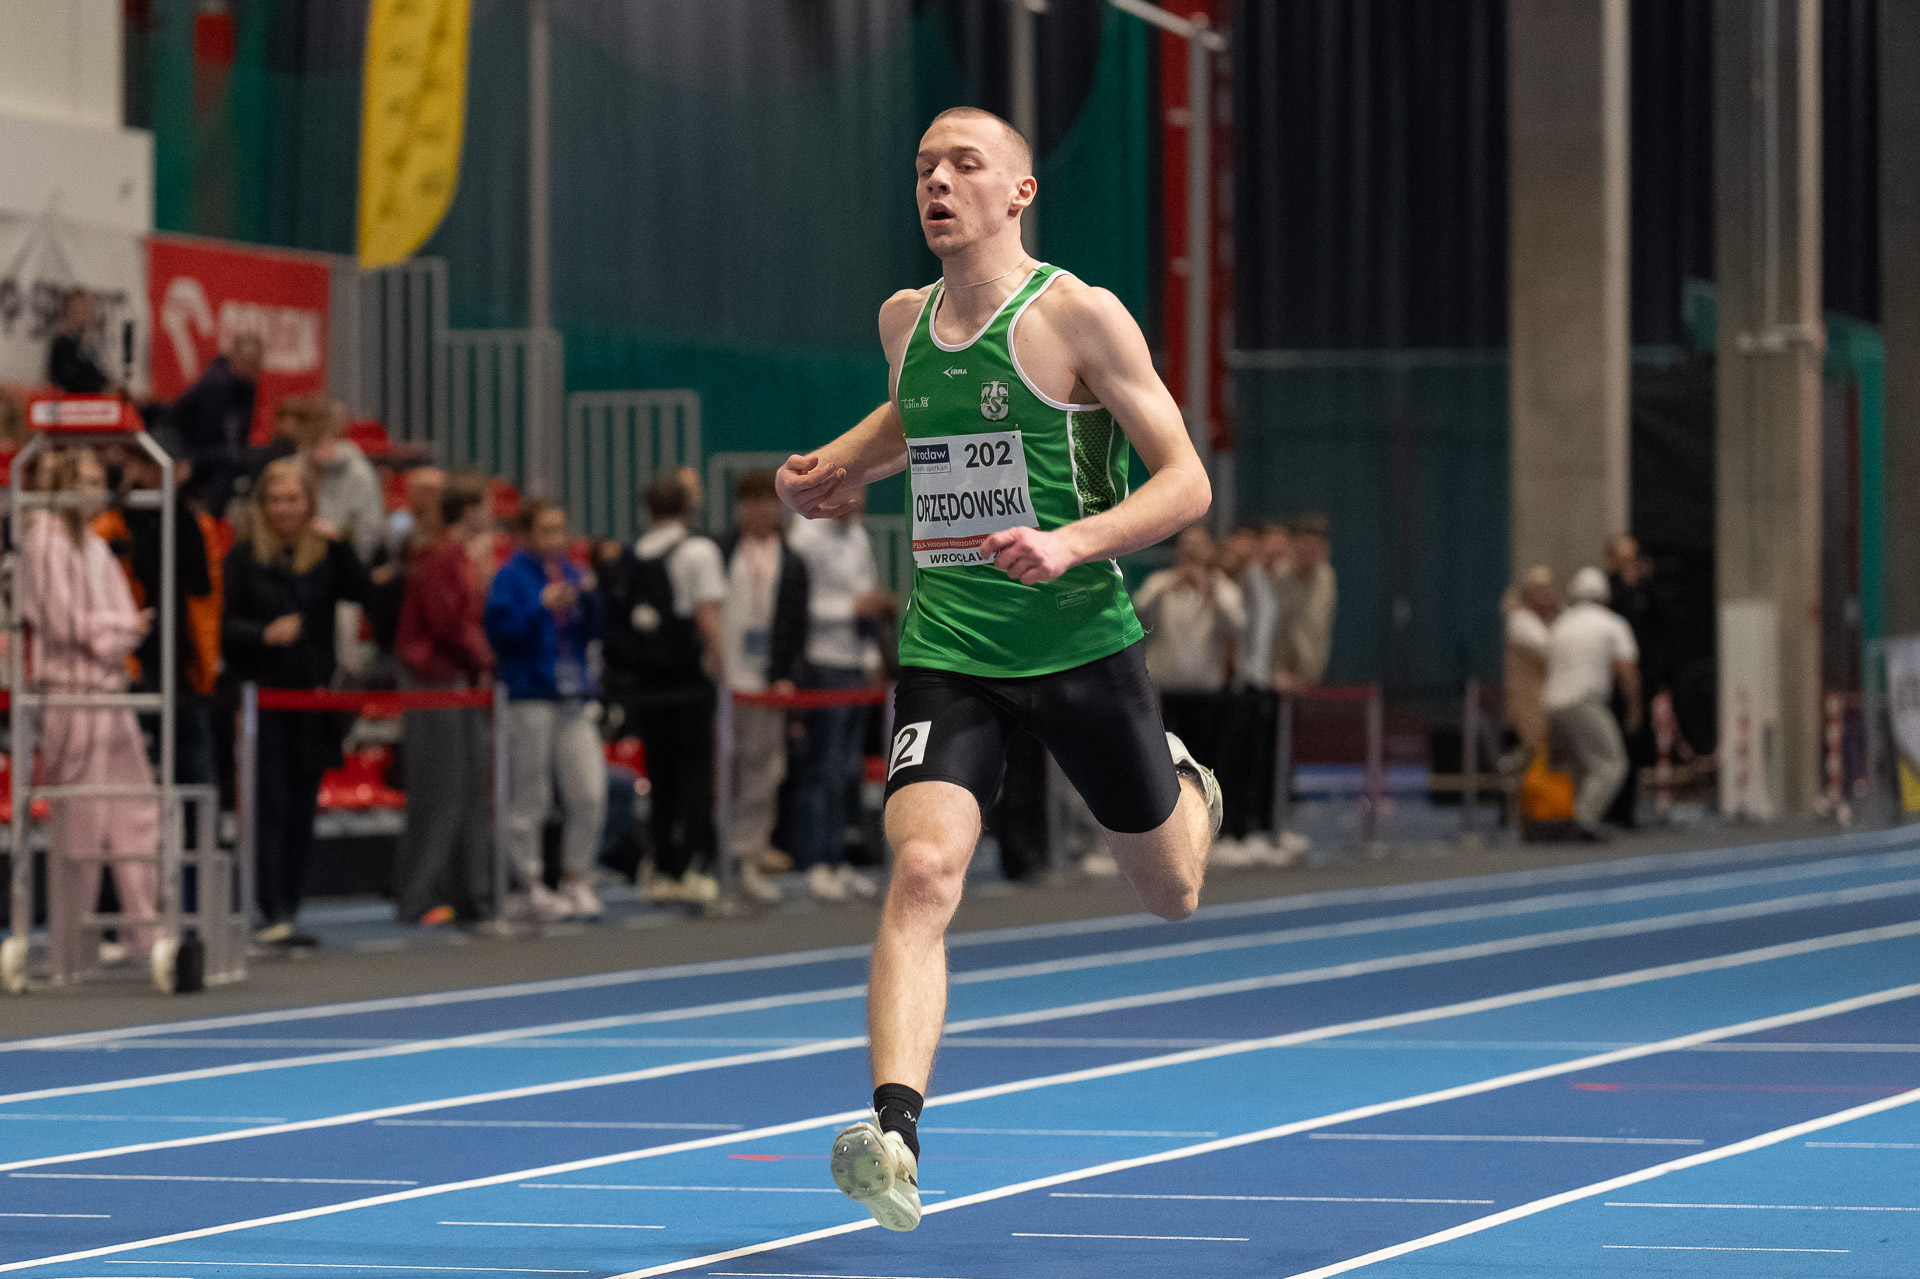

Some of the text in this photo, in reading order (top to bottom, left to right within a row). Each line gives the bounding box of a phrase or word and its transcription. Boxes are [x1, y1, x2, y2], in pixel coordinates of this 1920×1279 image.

[964, 440, 1013, 469] 202
[916, 486, 1027, 527] ORZĘDOWSKI
[892, 727, 919, 771] 2
